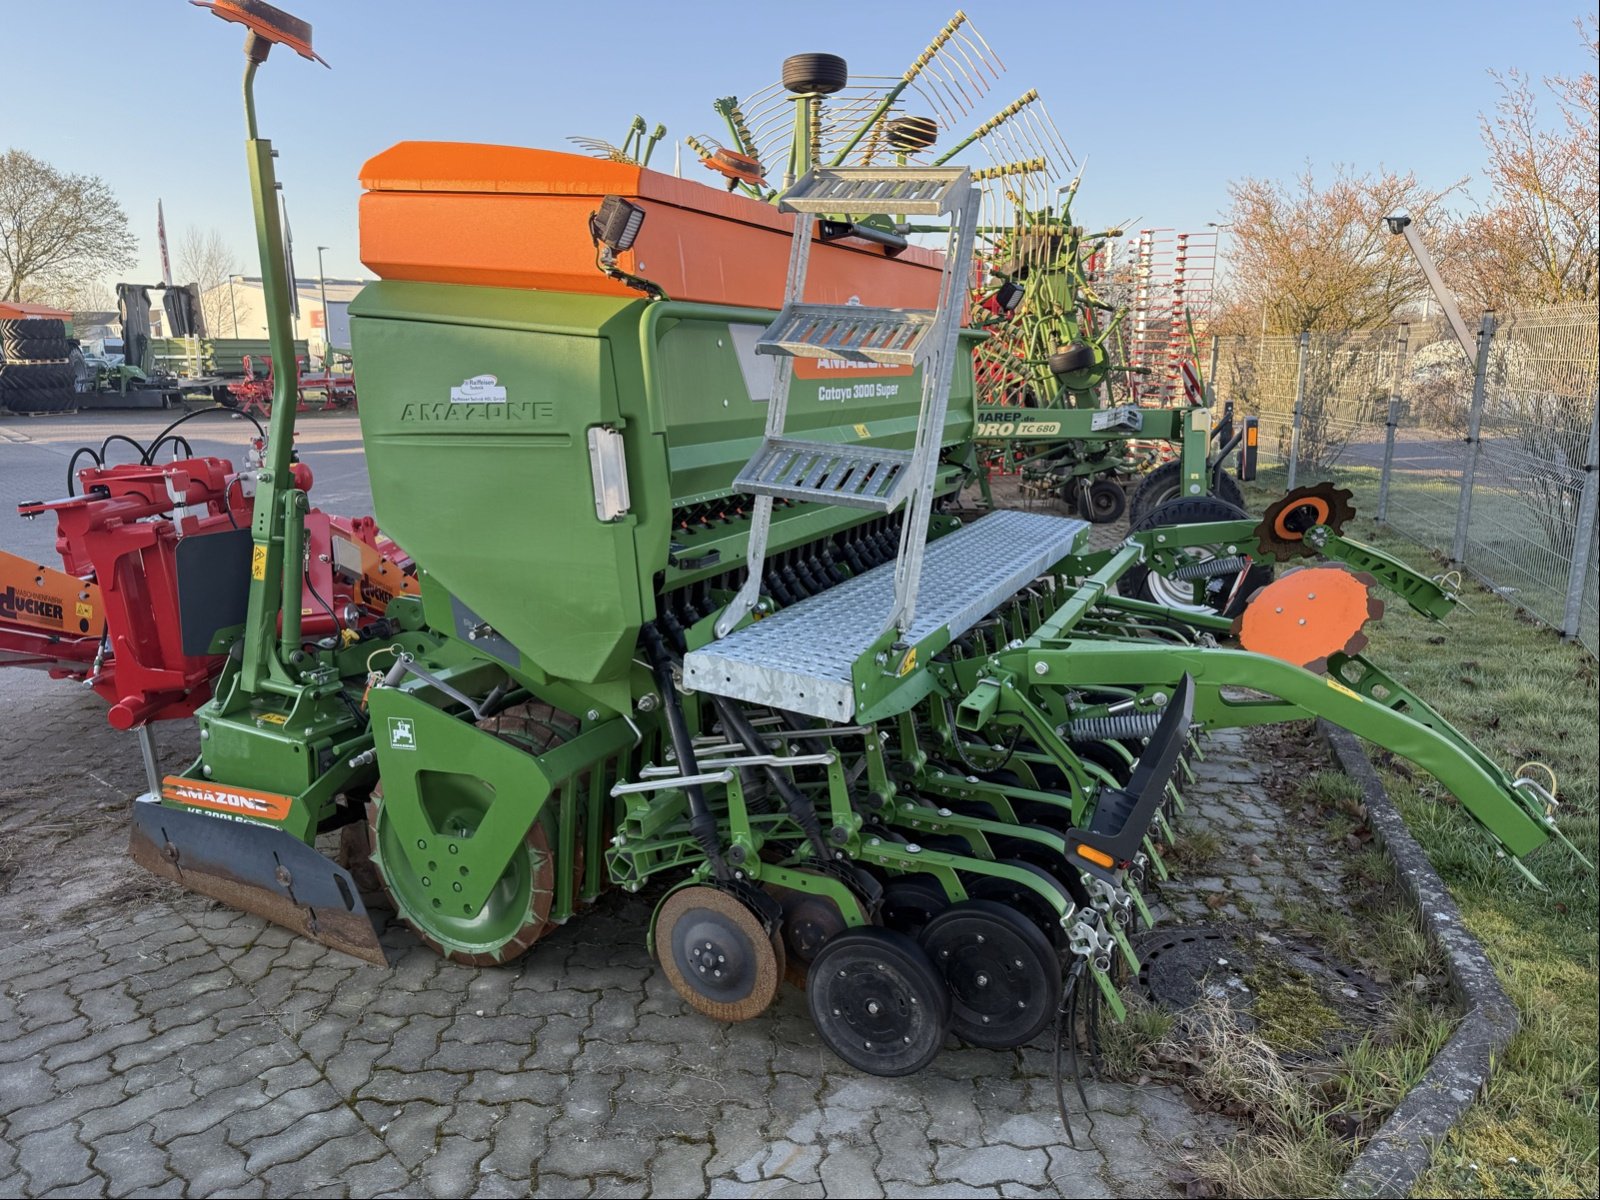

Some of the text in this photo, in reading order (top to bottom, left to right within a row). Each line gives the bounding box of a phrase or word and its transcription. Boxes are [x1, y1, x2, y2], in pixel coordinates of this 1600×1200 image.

[818, 383, 899, 403] Catoya 3000 Super
[401, 402, 553, 420] AMAZONE
[1022, 425, 1034, 433] TC
[1036, 424, 1056, 433] 680
[176, 784, 268, 812] AMAZONE
